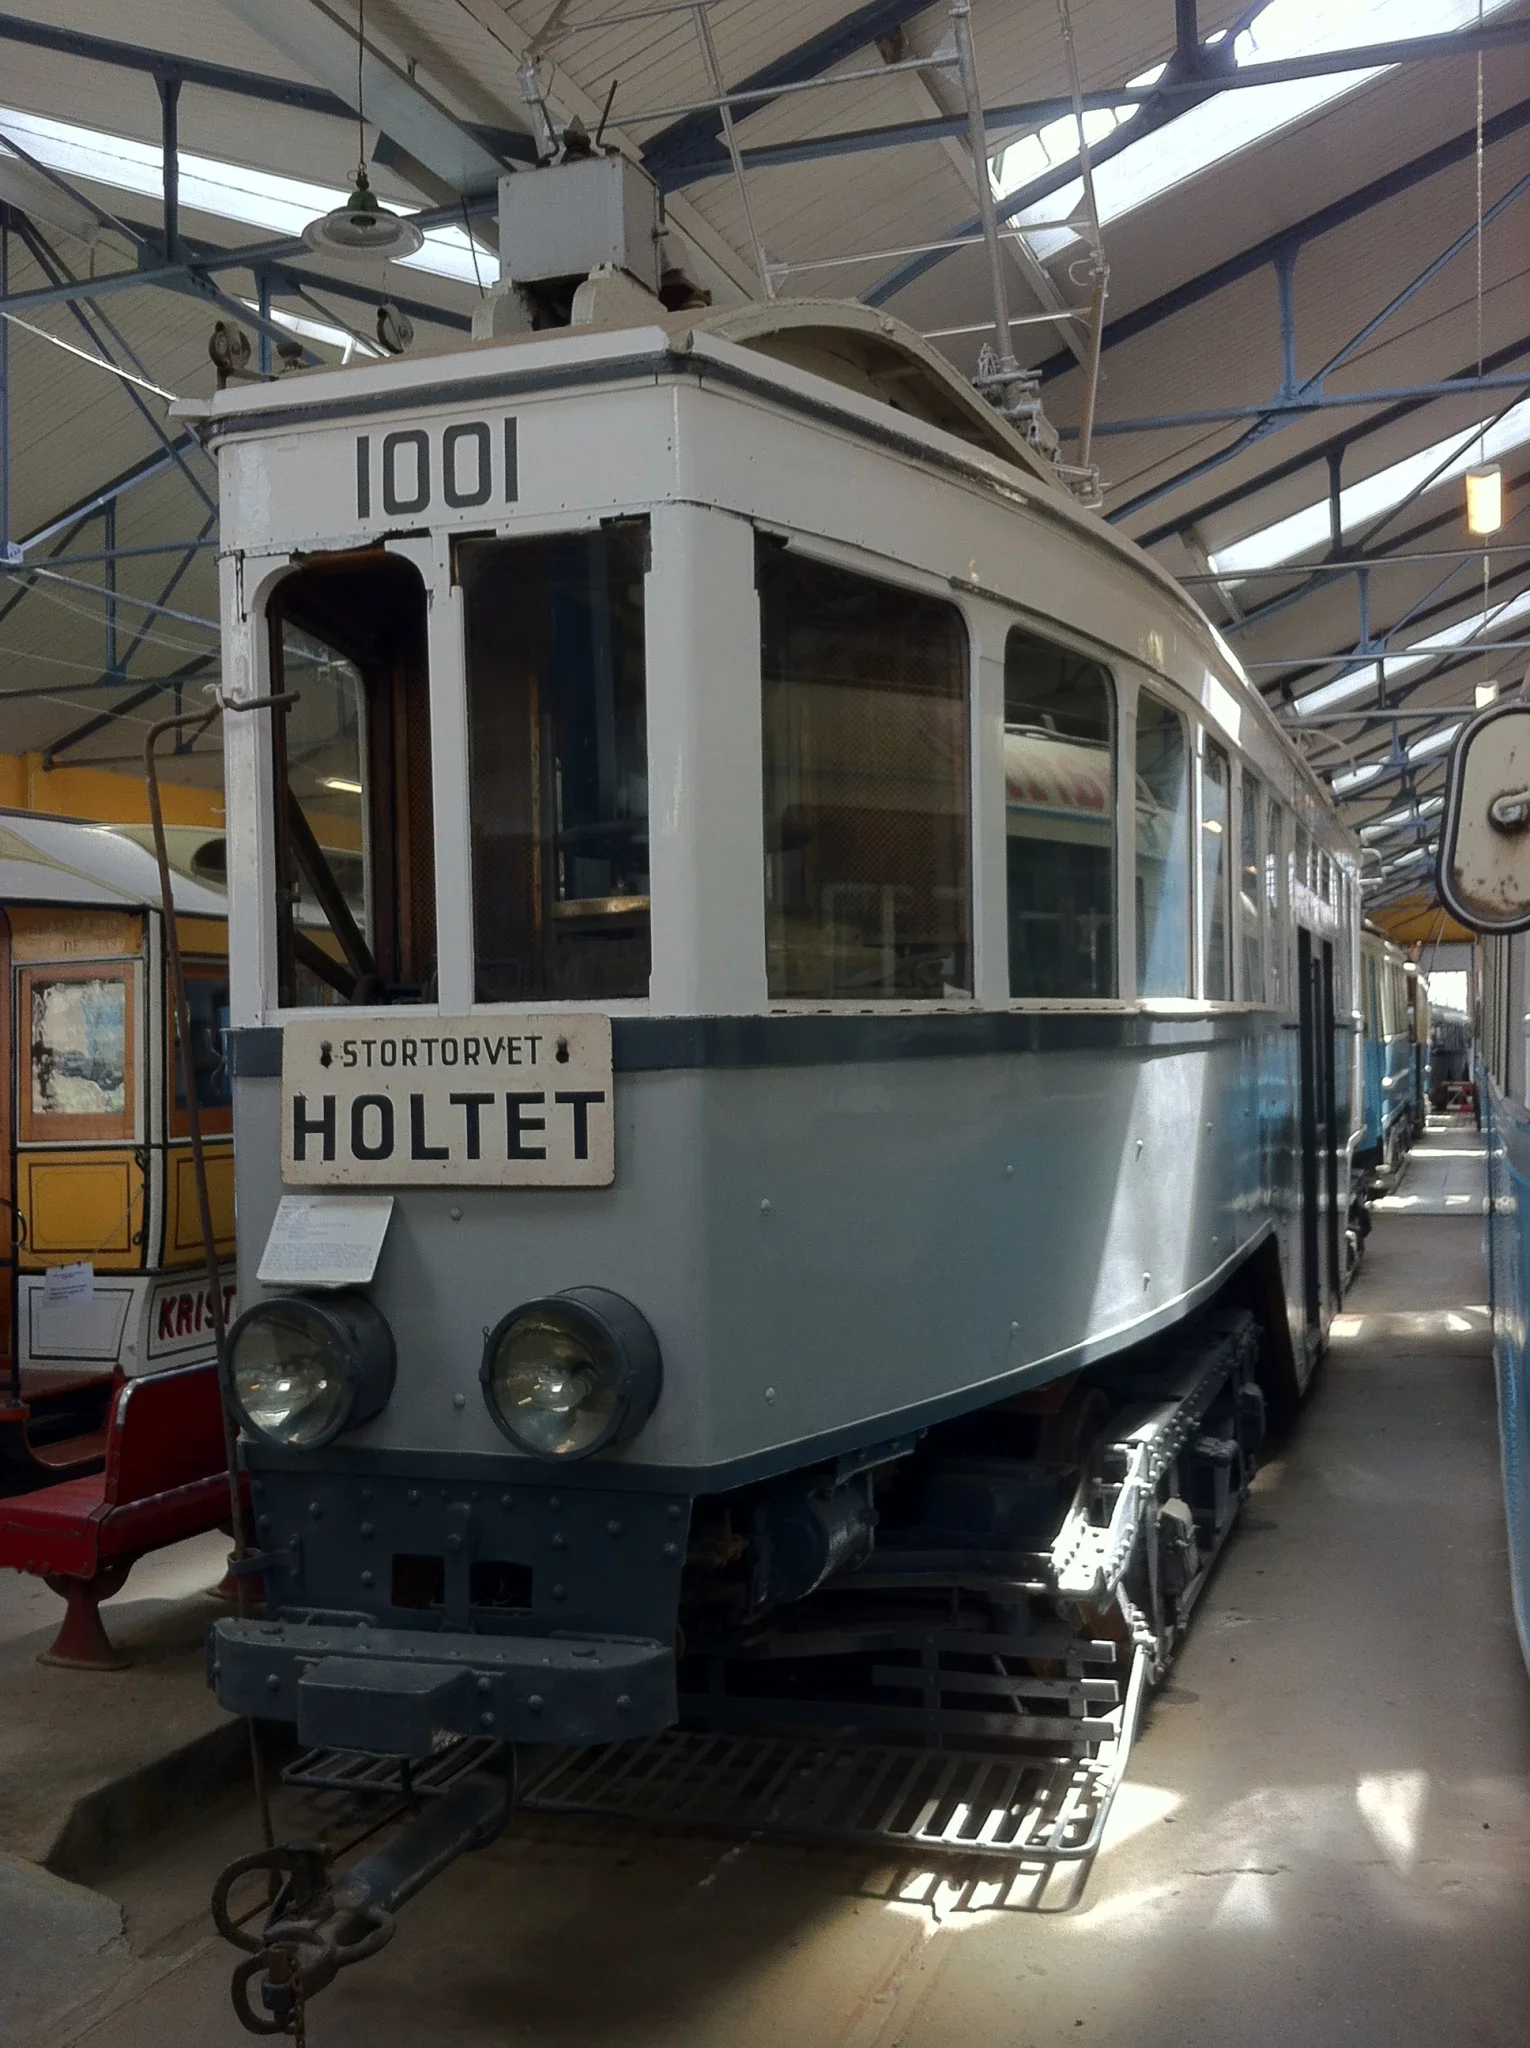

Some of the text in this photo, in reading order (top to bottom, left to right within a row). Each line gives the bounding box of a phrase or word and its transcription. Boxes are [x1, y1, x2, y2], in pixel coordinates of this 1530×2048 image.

[356, 416, 519, 519] 1001
[342, 1035, 543, 1068] STORTORVET
[292, 1090, 606, 1162] HOLTET
